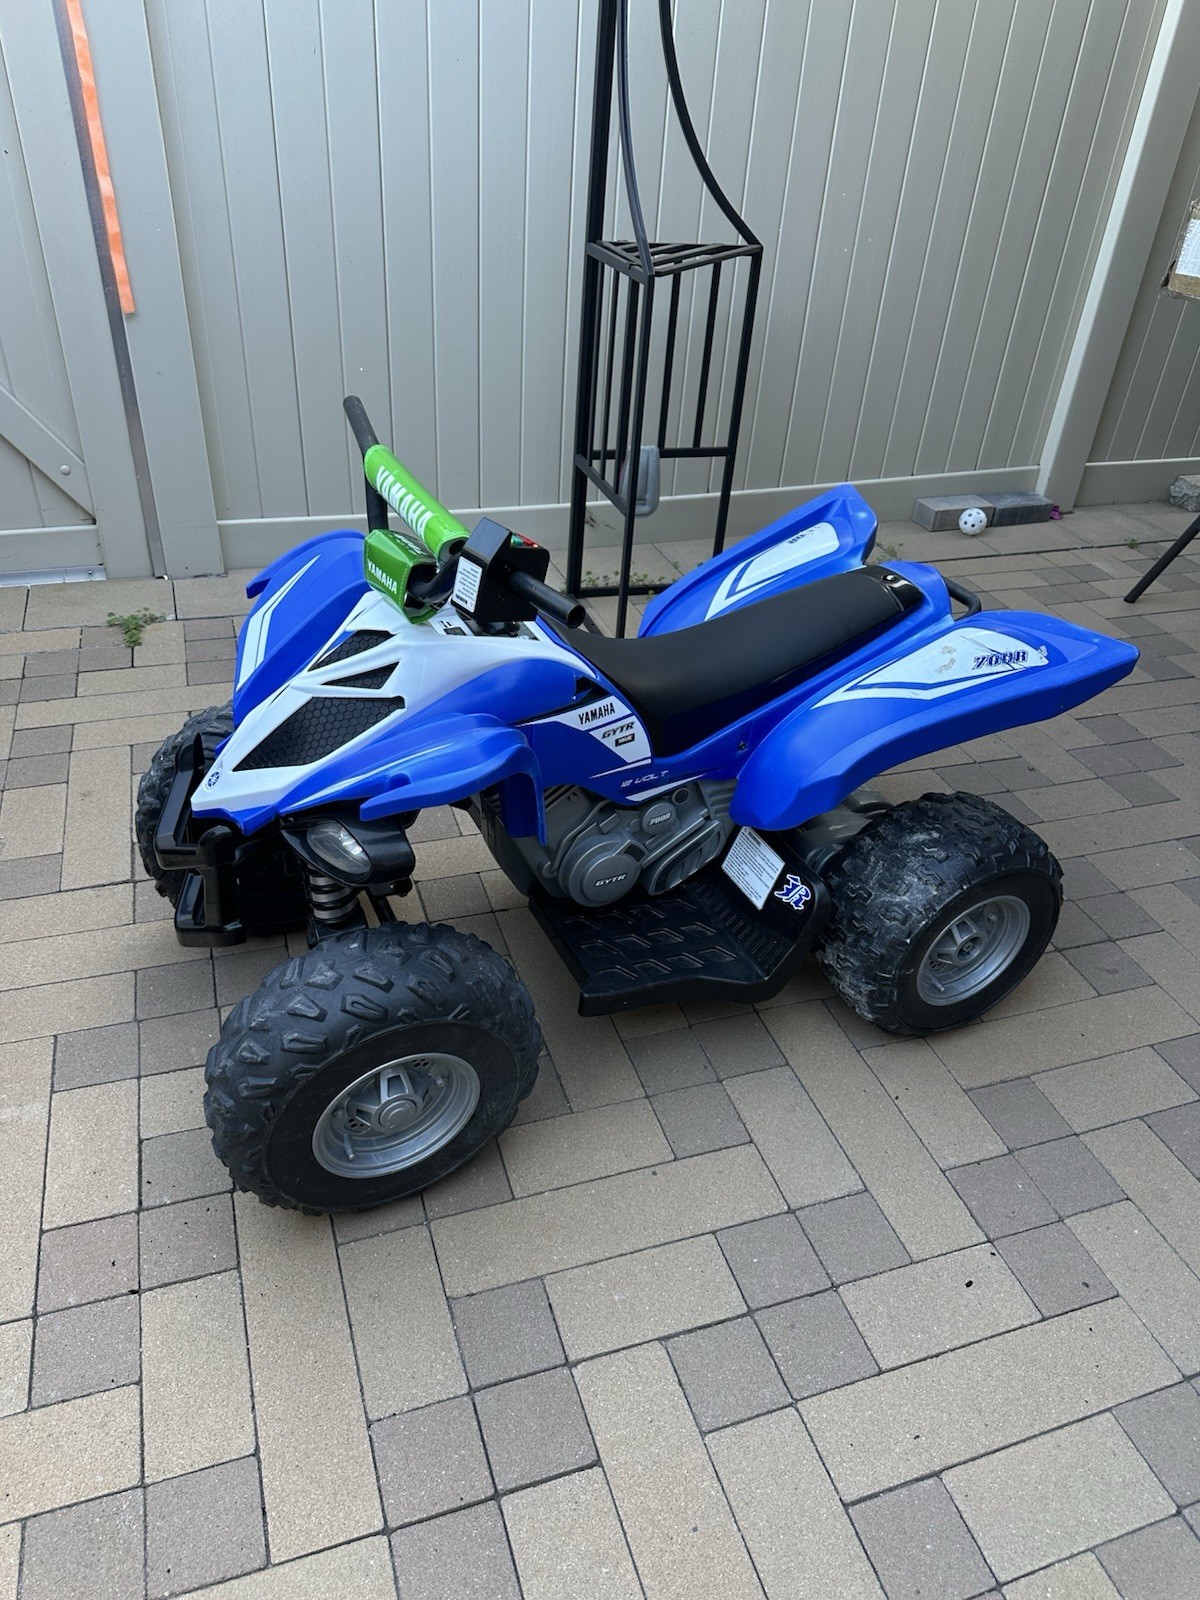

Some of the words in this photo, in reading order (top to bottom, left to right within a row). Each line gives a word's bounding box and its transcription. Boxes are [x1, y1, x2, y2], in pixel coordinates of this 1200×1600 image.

[375, 465, 434, 542] YAMAHA
[367, 558, 398, 595] YAMAHA
[578, 702, 616, 725] YAMAHA
[602, 721, 636, 739] GYTR
[634, 770, 669, 784] VOLT
[595, 873, 627, 887] GYTR
